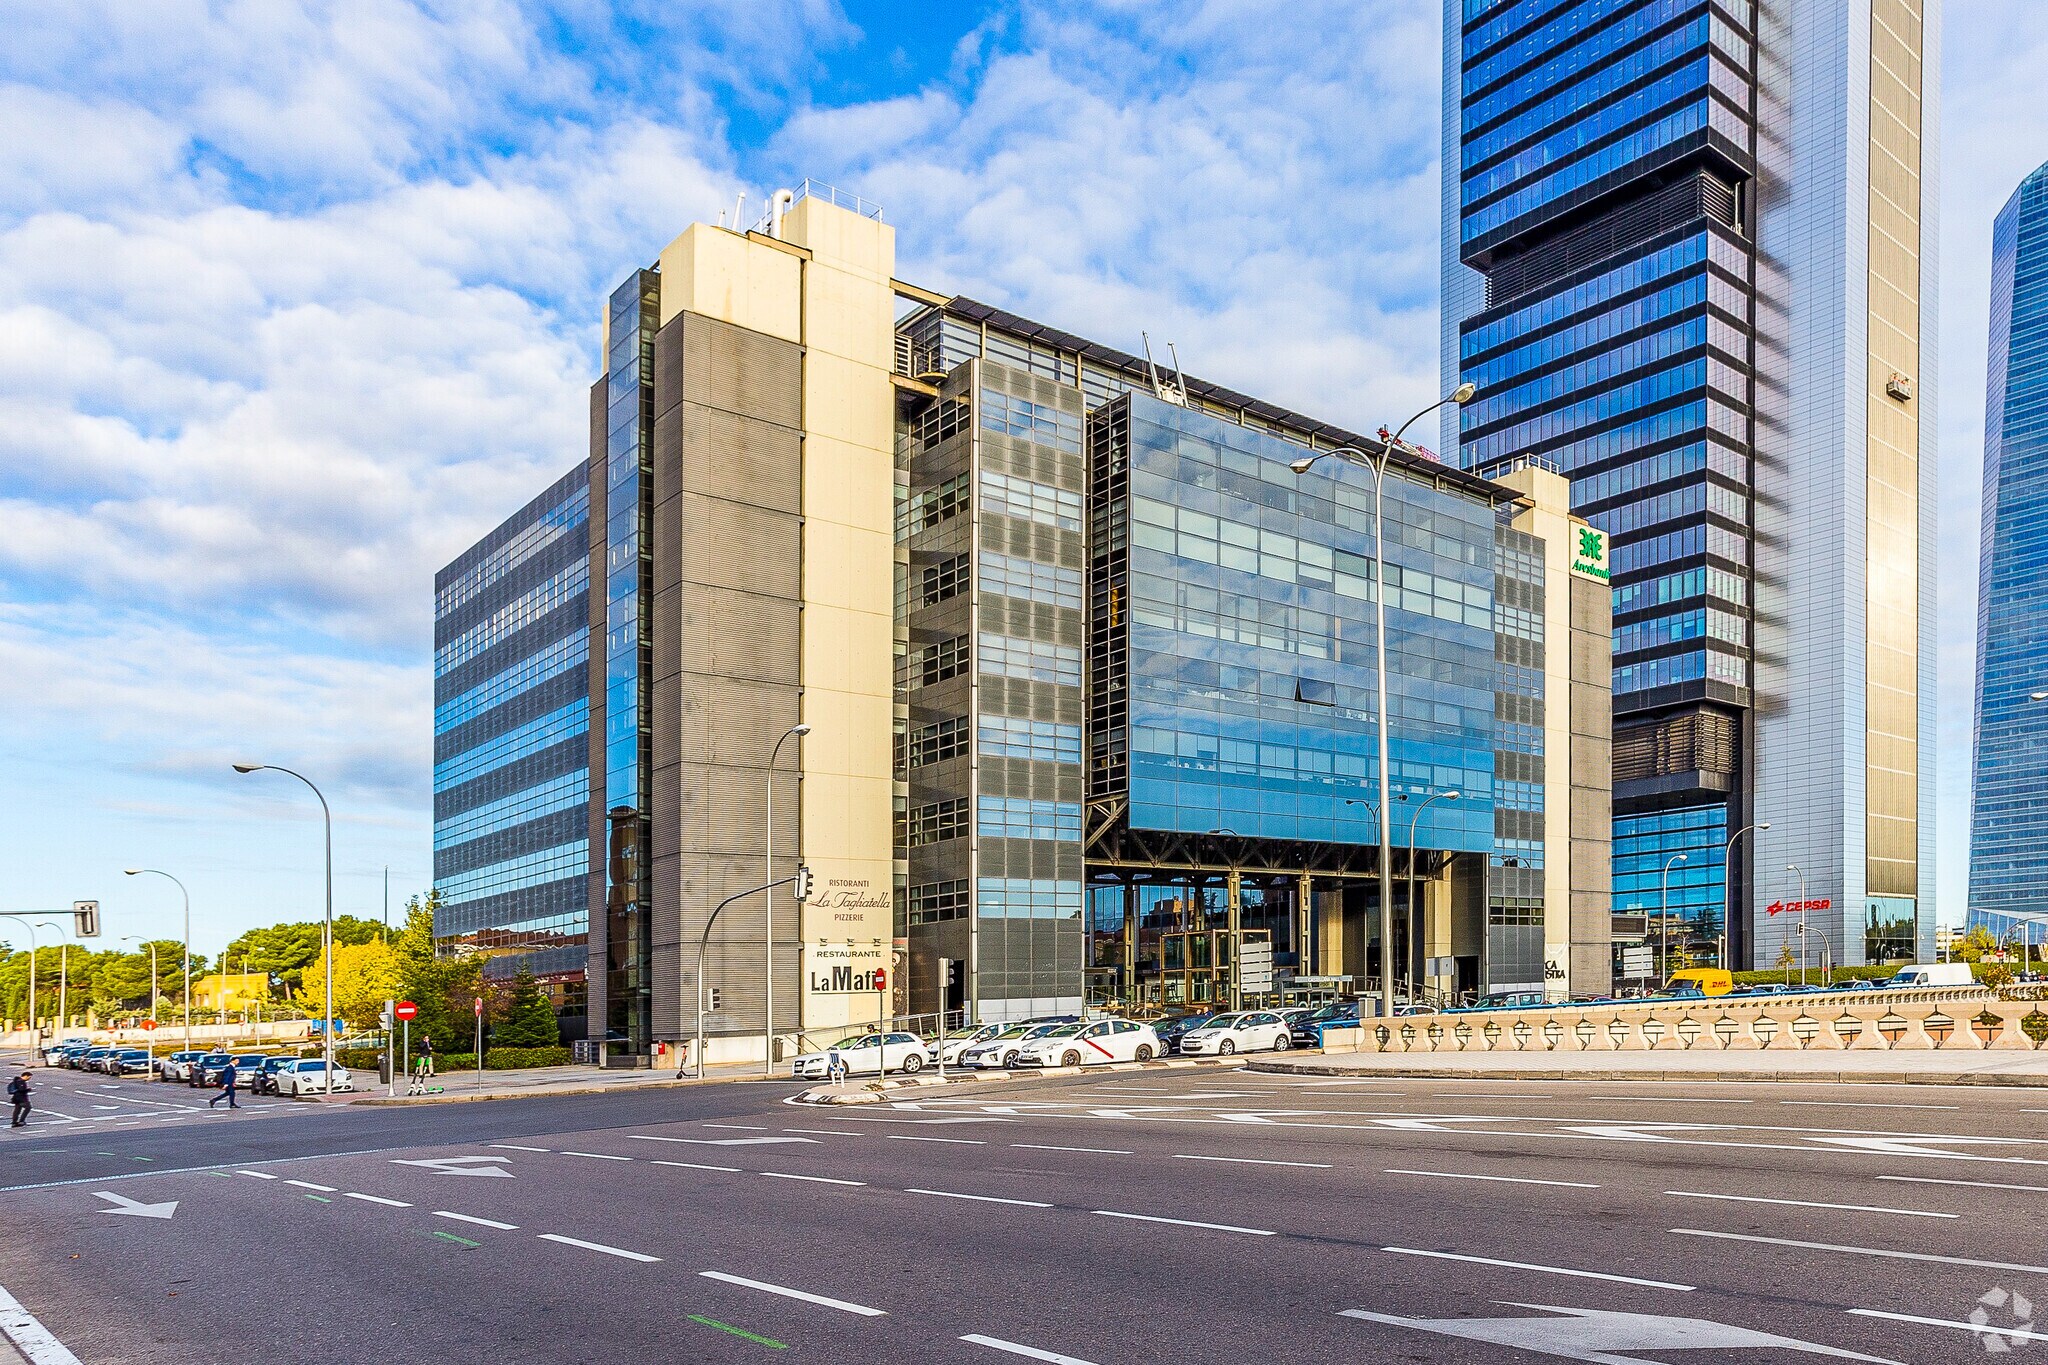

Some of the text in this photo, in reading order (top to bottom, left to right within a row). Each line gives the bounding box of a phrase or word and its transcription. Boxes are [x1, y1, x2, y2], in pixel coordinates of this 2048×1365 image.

[829, 879, 870, 887] RISTORANTI
[807, 890, 891, 911] La Tagliatella
[1786, 899, 1831, 912] CEPSA
[834, 913, 864, 921] PIZZERIE
[811, 966, 887, 991] La Mafi
